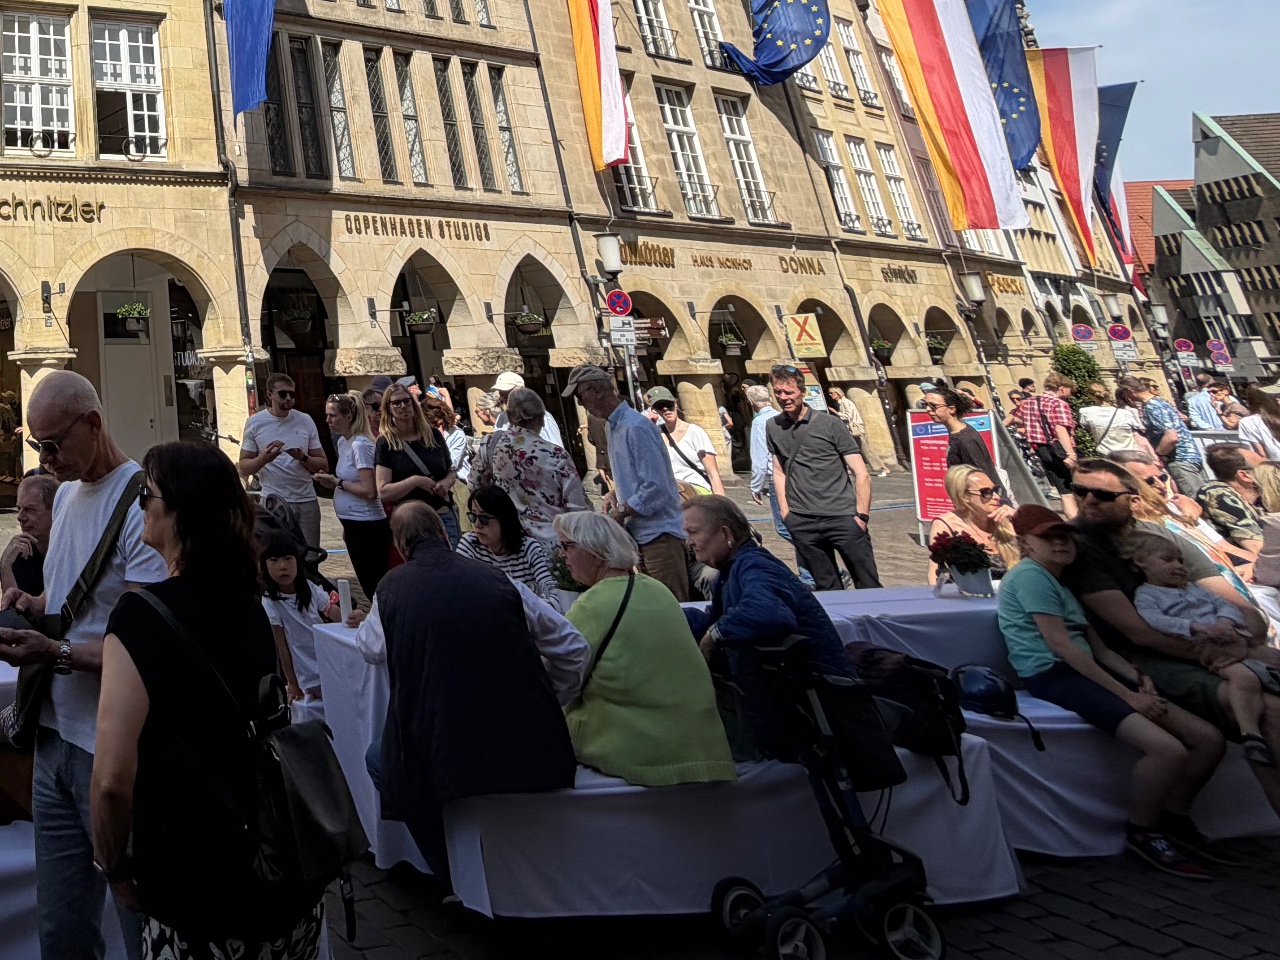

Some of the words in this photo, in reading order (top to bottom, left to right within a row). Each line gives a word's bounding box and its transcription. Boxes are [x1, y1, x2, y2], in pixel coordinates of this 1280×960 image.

[345, 213, 433, 240] COPENHAGEN
[437, 219, 491, 242] STUDIOS
[691, 255, 714, 268] HAUS
[778, 255, 825, 276] DONNA
